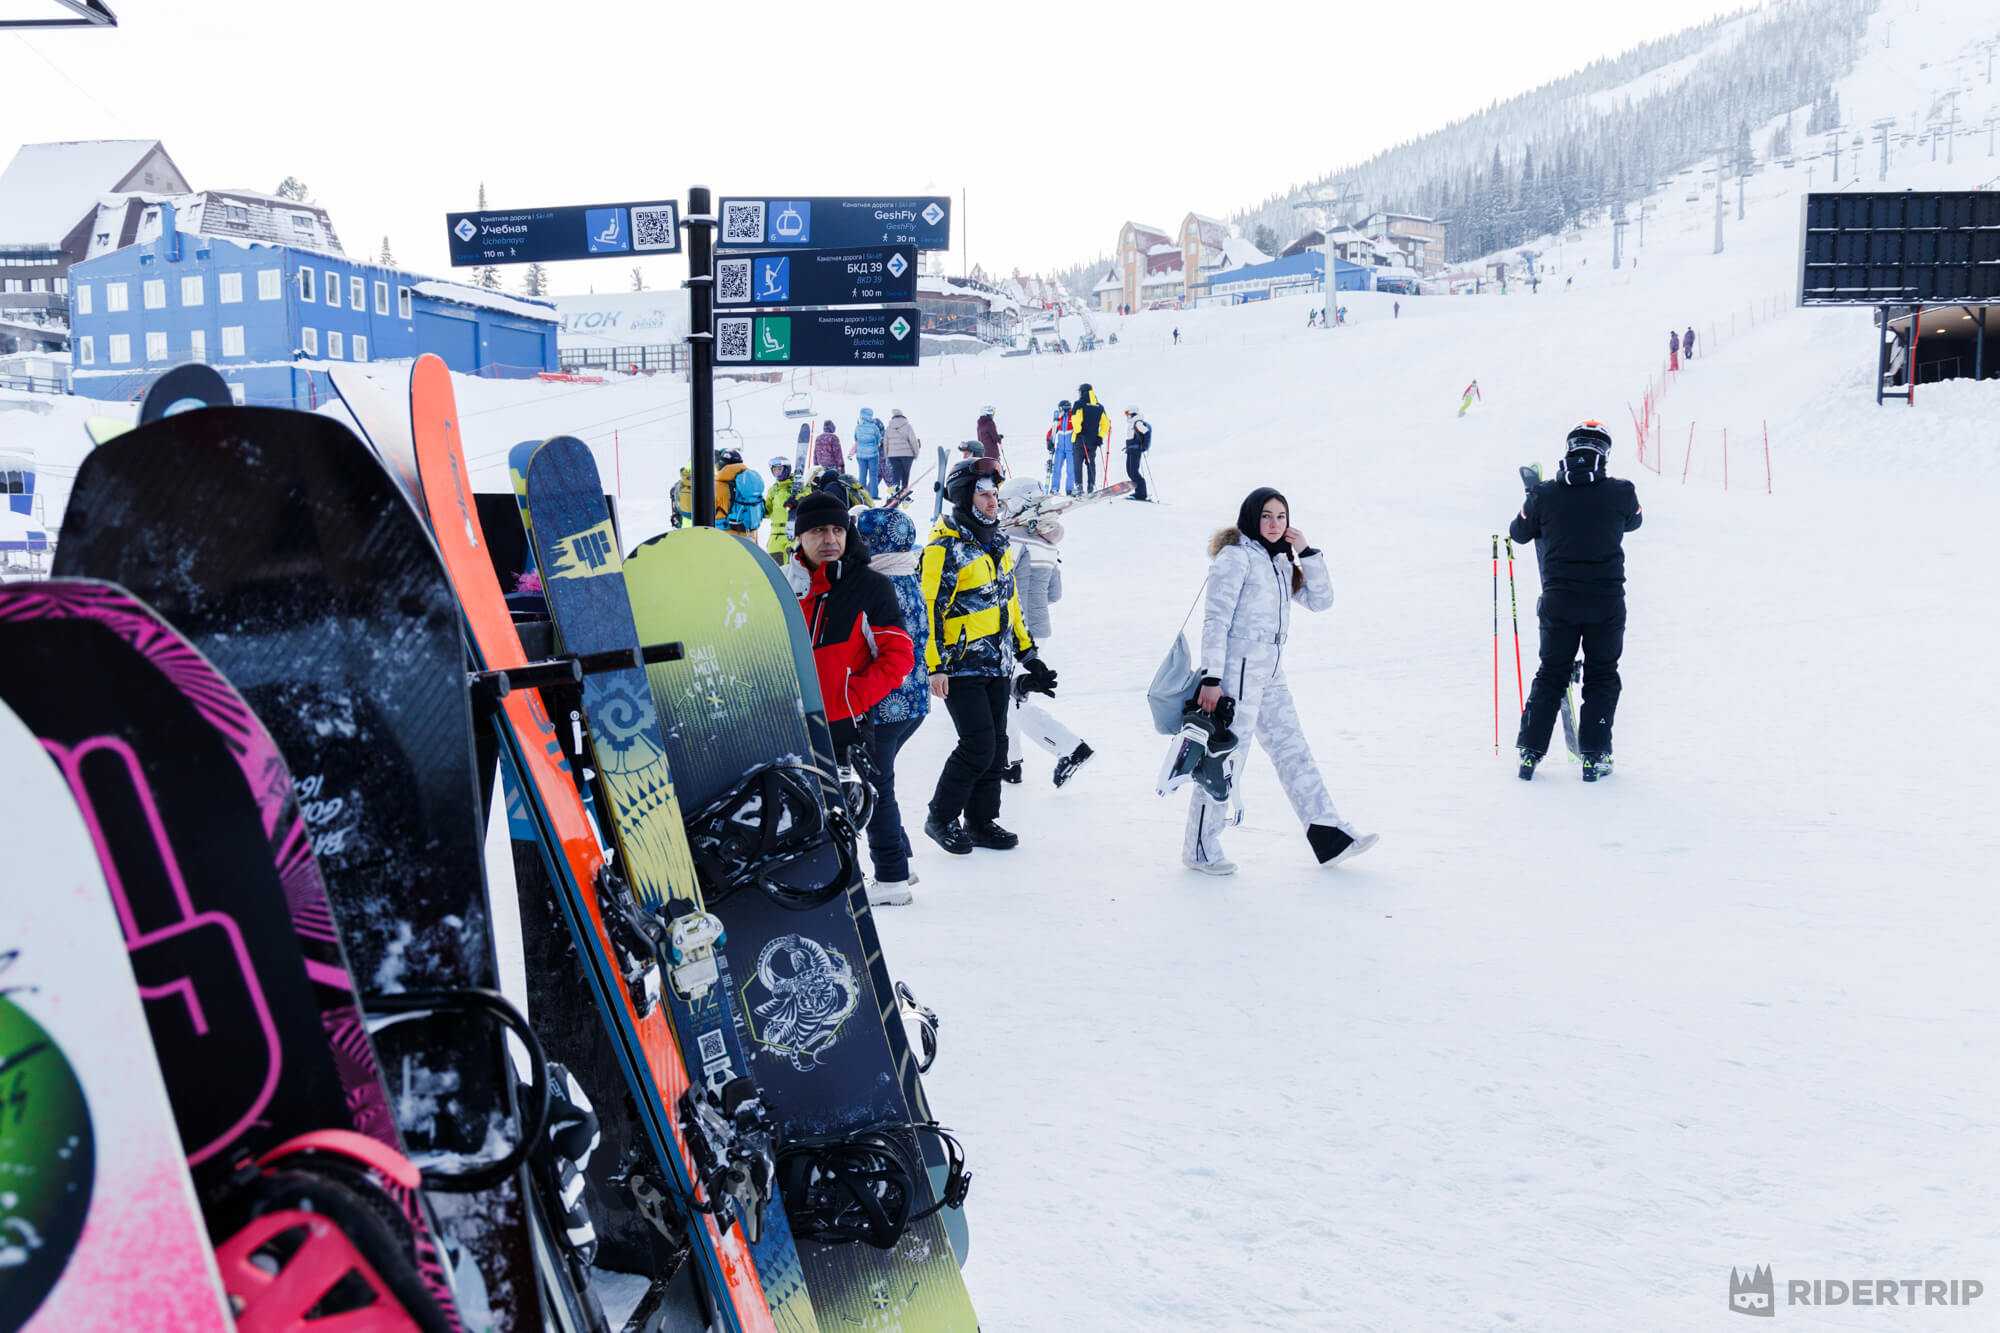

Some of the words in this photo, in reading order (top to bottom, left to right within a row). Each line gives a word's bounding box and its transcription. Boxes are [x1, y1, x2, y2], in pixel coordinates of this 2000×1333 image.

[480, 215, 509, 223] Канатная
[510, 213, 531, 222] дорога
[874, 210, 917, 222] GeshFly
[481, 224, 528, 235] Учебная
[886, 223, 917, 231] GeshFly
[483, 250, 496, 258] 110
[843, 254, 863, 262] дорога
[847, 263, 868, 274] БКД
[869, 262, 883, 273] 39
[861, 289, 874, 297] 100
[844, 325, 885, 336] Булочка
[862, 351, 876, 359] 280
